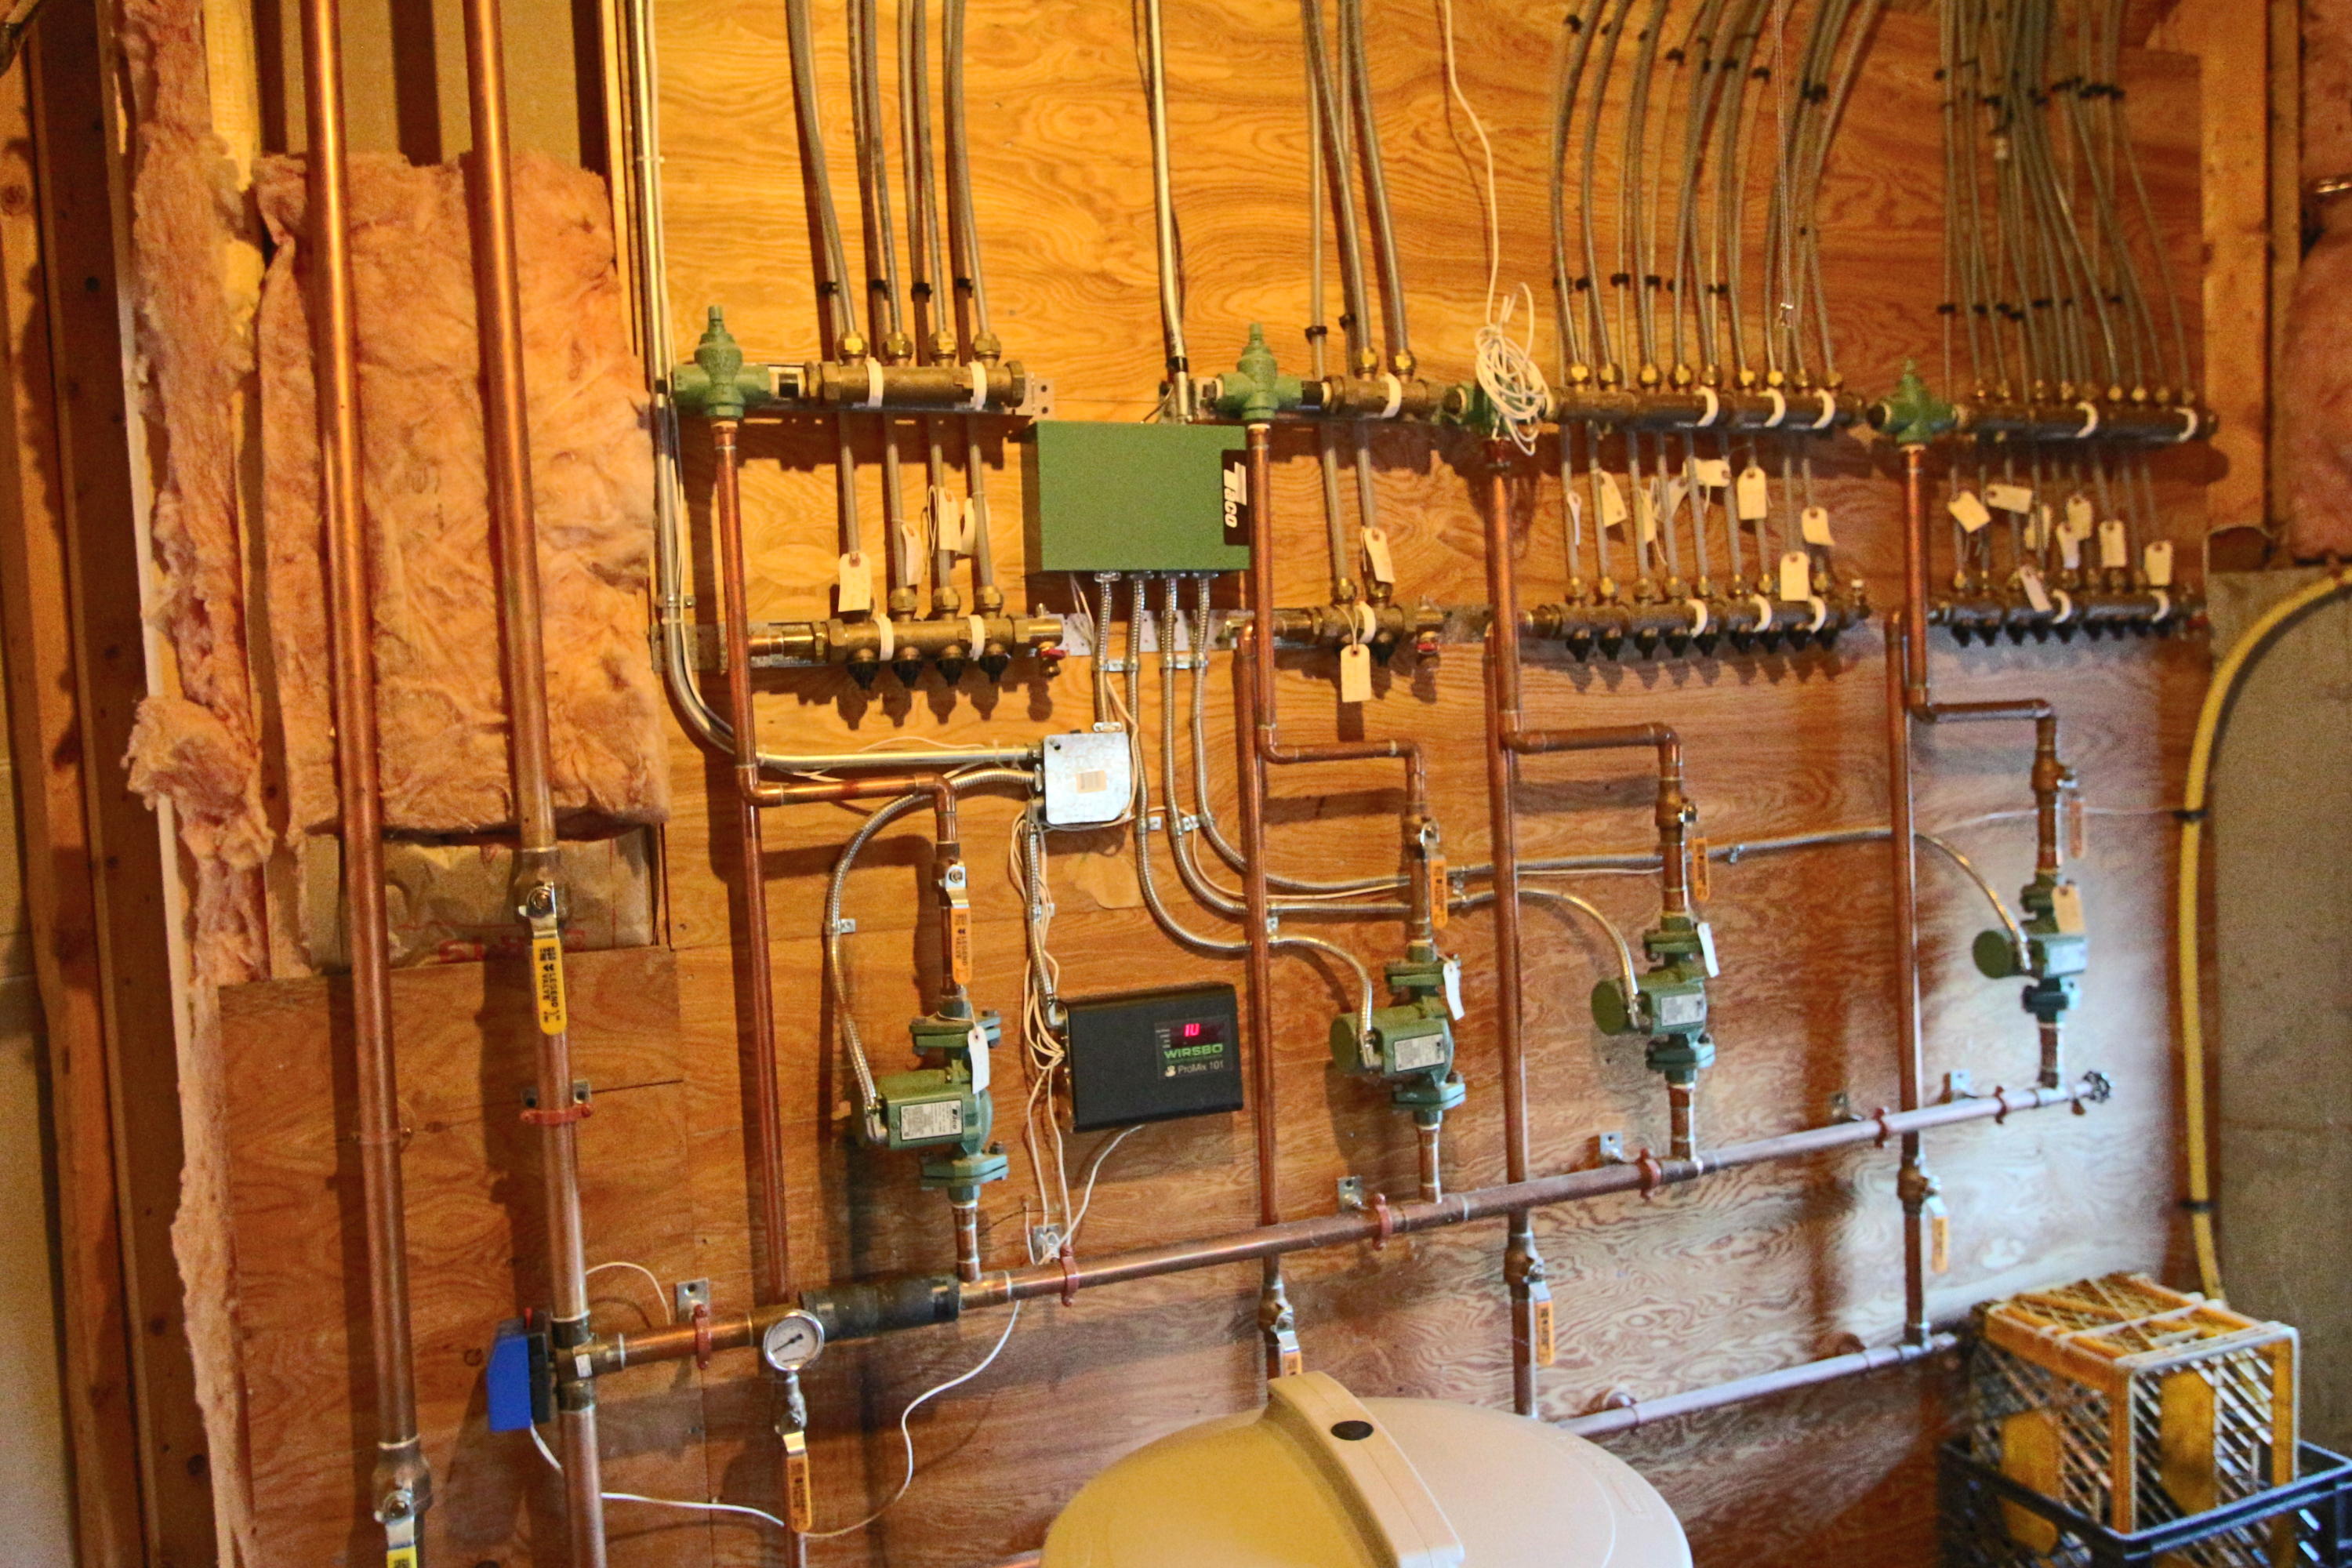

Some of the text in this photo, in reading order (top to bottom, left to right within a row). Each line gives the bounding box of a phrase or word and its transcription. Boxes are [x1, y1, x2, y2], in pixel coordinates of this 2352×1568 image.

[550, 973, 558, 1007] LEGEND
[1163, 1043, 1224, 1058] WIRSBO
[1178, 1060, 1224, 1074] ProMix 101
